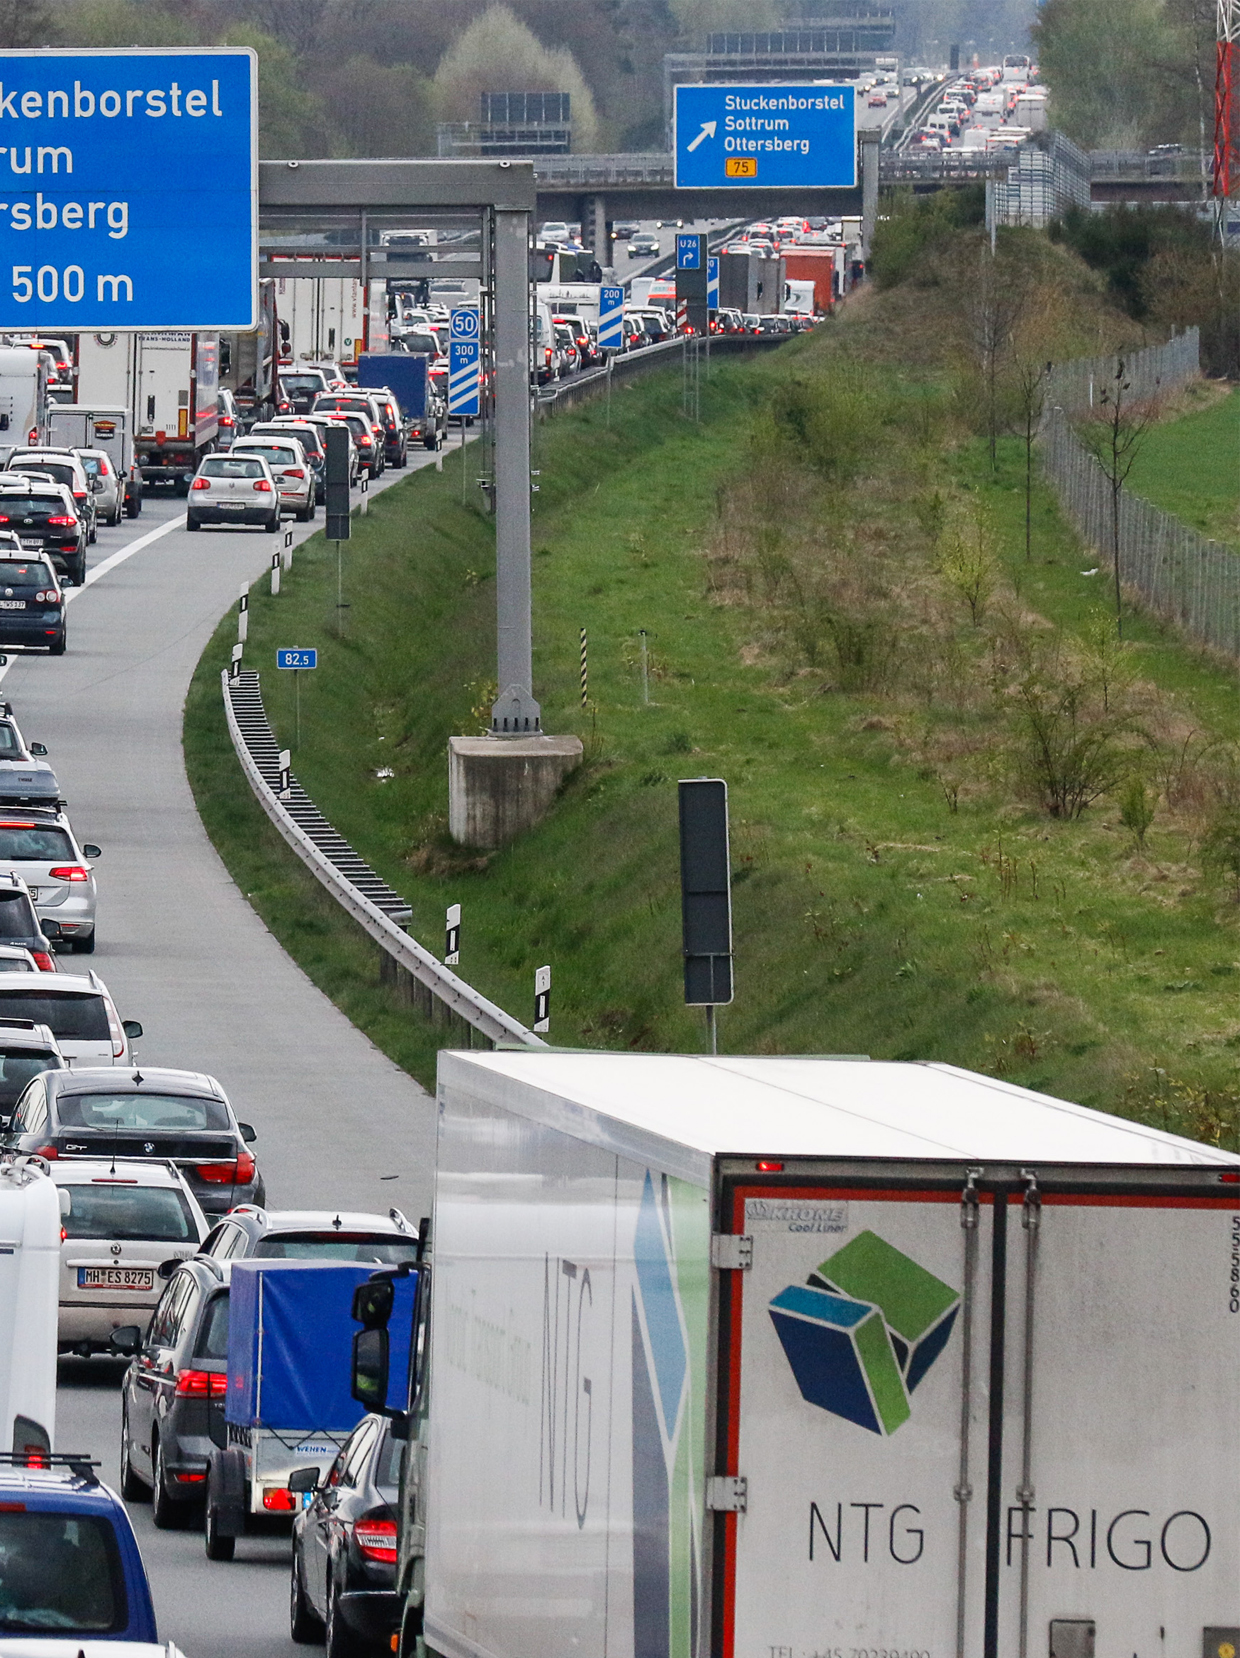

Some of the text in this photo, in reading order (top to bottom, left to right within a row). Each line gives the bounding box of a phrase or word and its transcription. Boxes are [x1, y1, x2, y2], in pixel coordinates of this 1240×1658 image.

[724, 94, 845, 110] Stuckenborstel
[724, 116, 789, 131] Sottrum
[724, 136, 810, 154] Ottersberg
[733, 160, 749, 174] 75
[12, 264, 134, 303] 500 m
[604, 290, 620, 299] 200
[455, 316, 475, 332] 50
[455, 345, 474, 356] 300
[788, 1223, 847, 1233] Cool Liner
[86, 1270, 151, 1284] MH ES 8275
[809, 1501, 1213, 1573] NTG FRIGO
